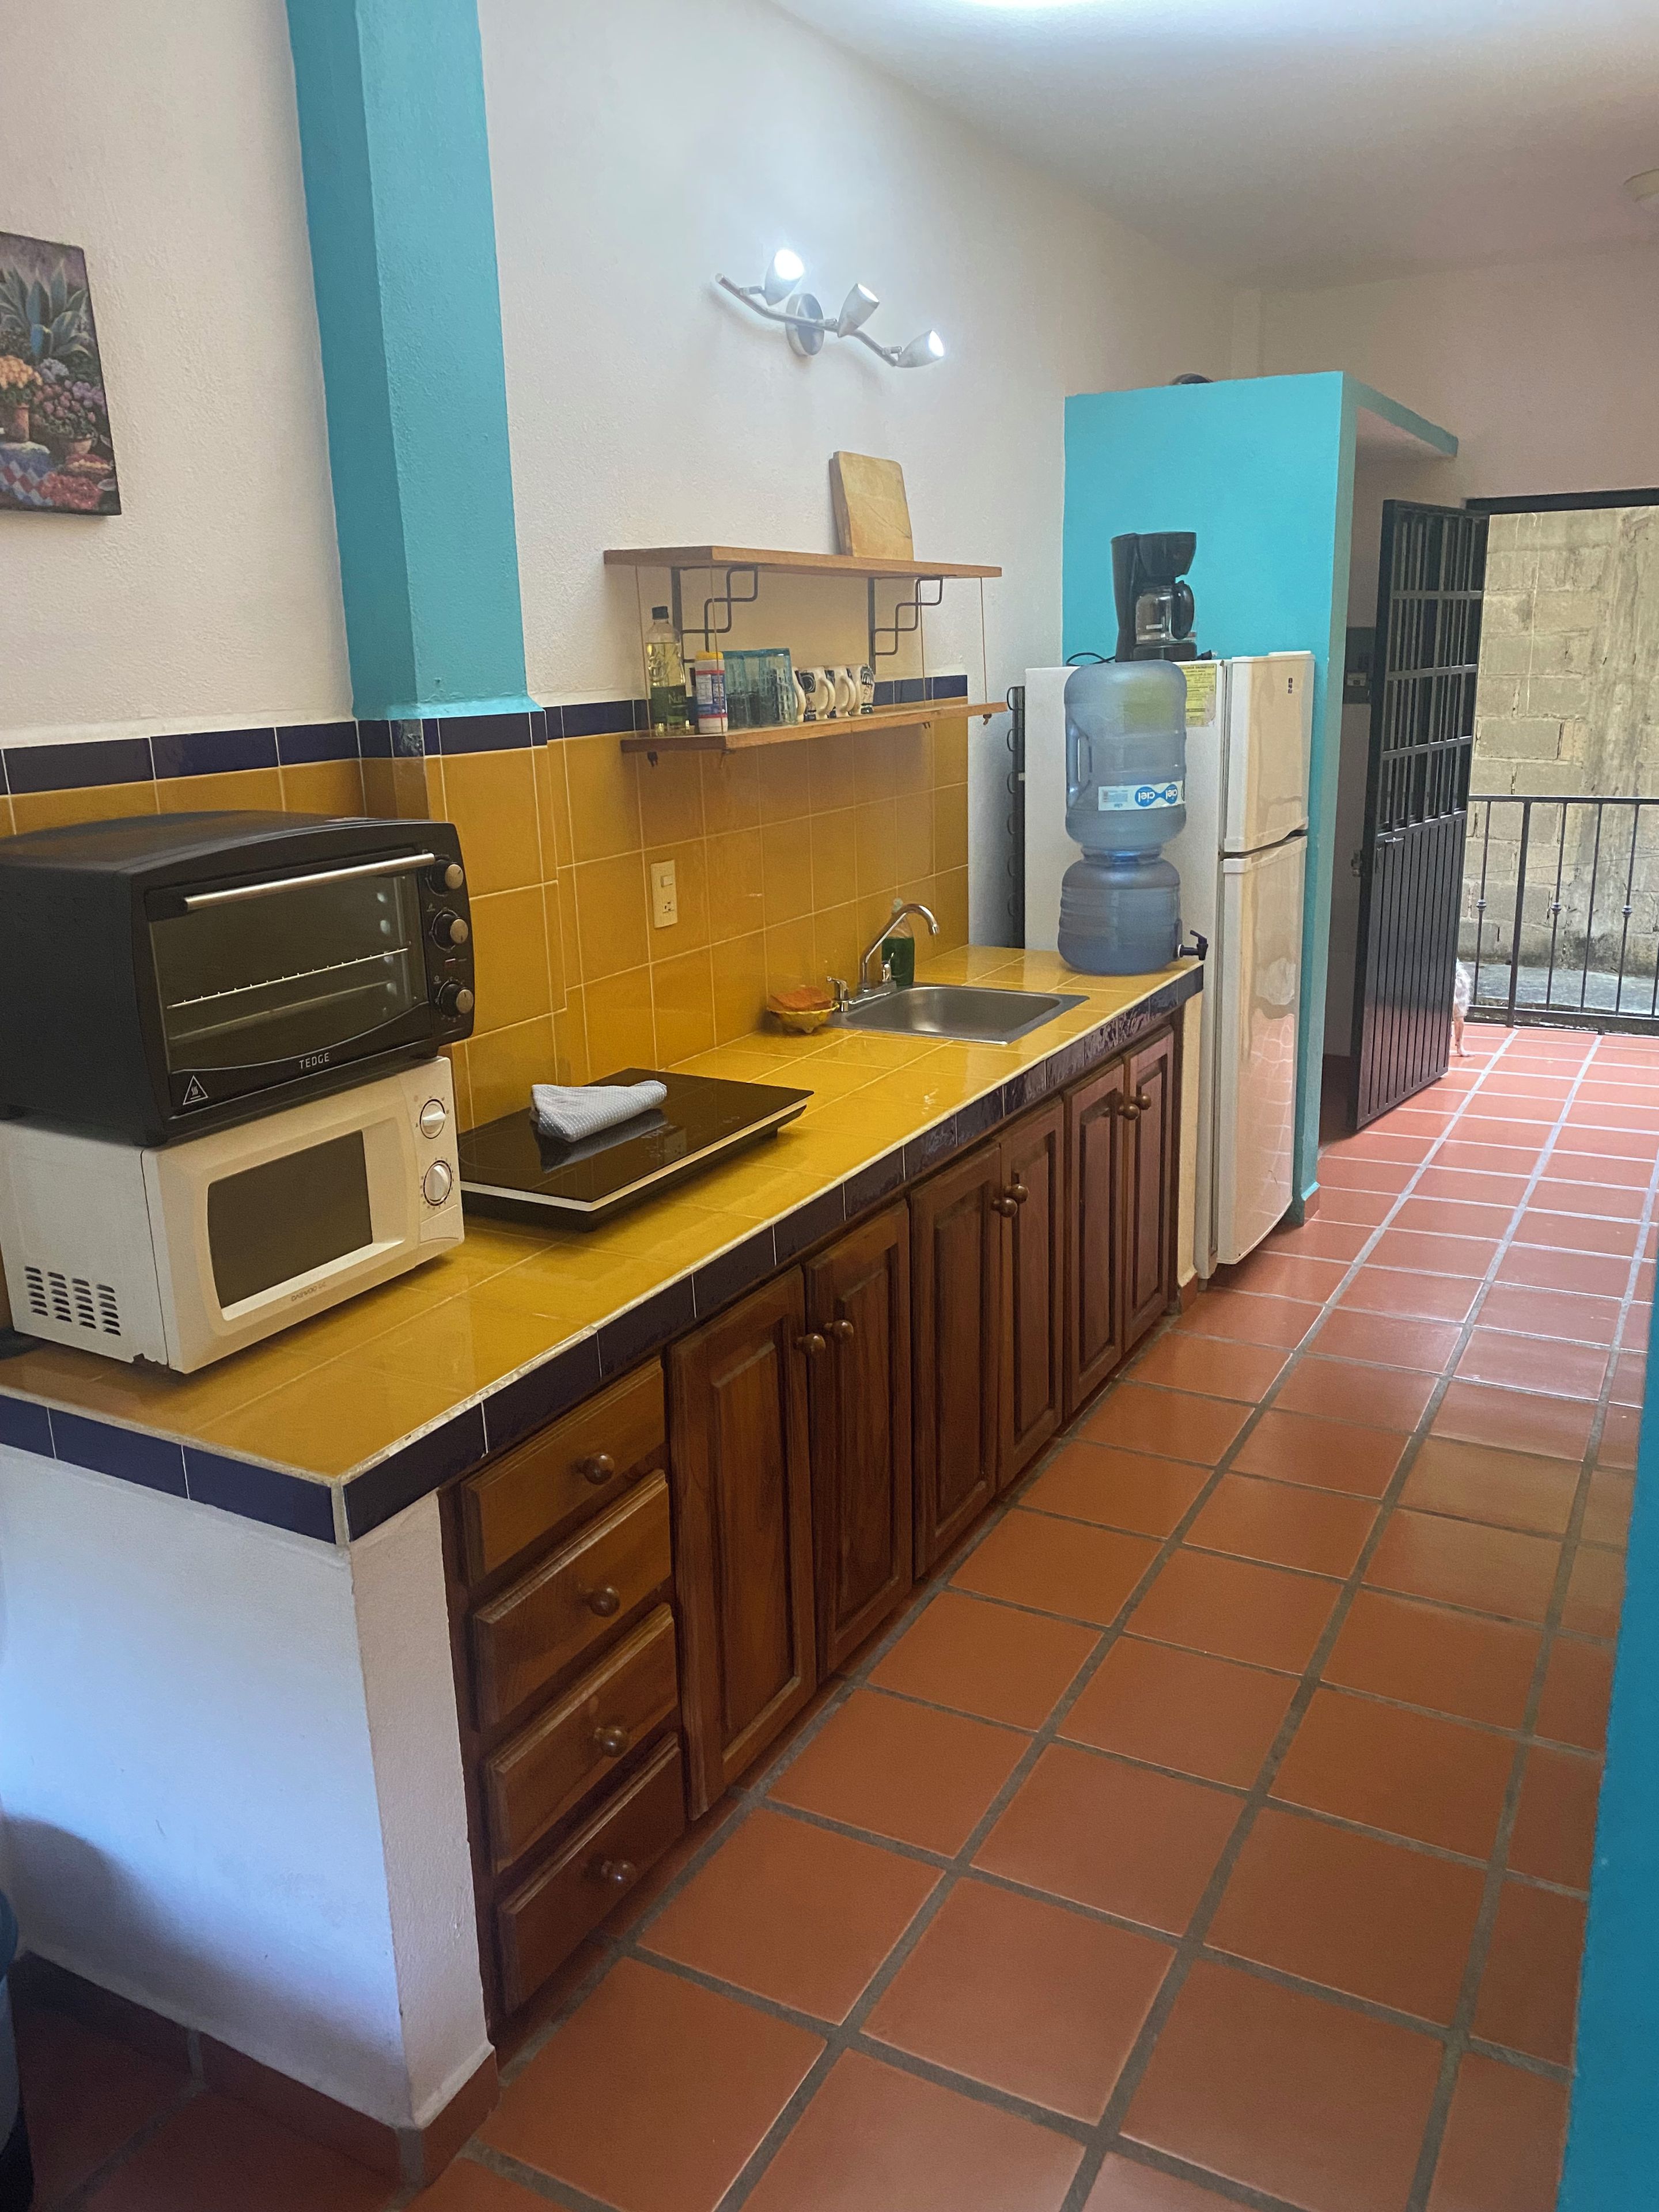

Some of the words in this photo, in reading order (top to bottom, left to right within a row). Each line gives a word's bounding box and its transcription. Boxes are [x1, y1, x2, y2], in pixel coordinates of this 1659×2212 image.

[1138, 790, 1156, 802] ciel
[1165, 789, 1177, 800] ciel
[298, 1052, 330, 1070] TEDGE
